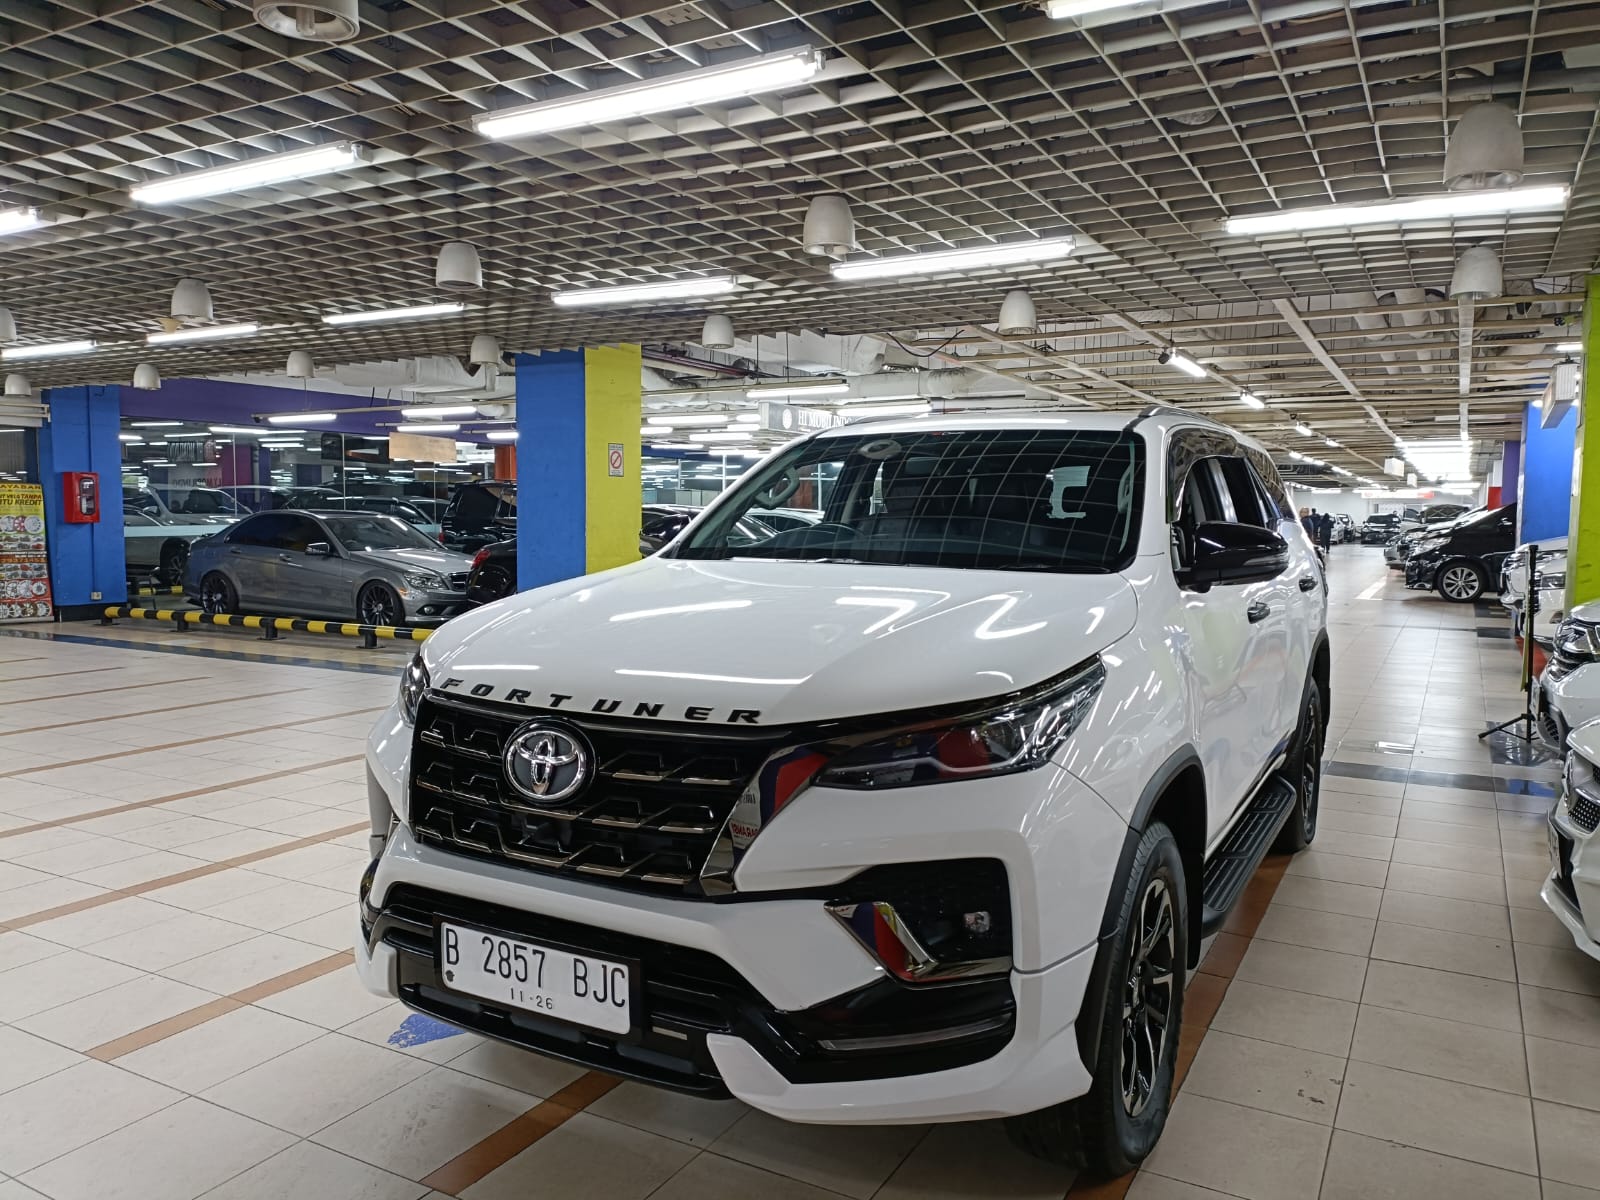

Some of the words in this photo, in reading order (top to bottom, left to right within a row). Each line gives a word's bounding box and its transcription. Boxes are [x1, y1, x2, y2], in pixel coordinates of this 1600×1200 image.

[440, 677, 761, 724] FORTUNER
[446, 928, 459, 965] B
[481, 936, 546, 988] 2857
[573, 958, 626, 1007] BJC
